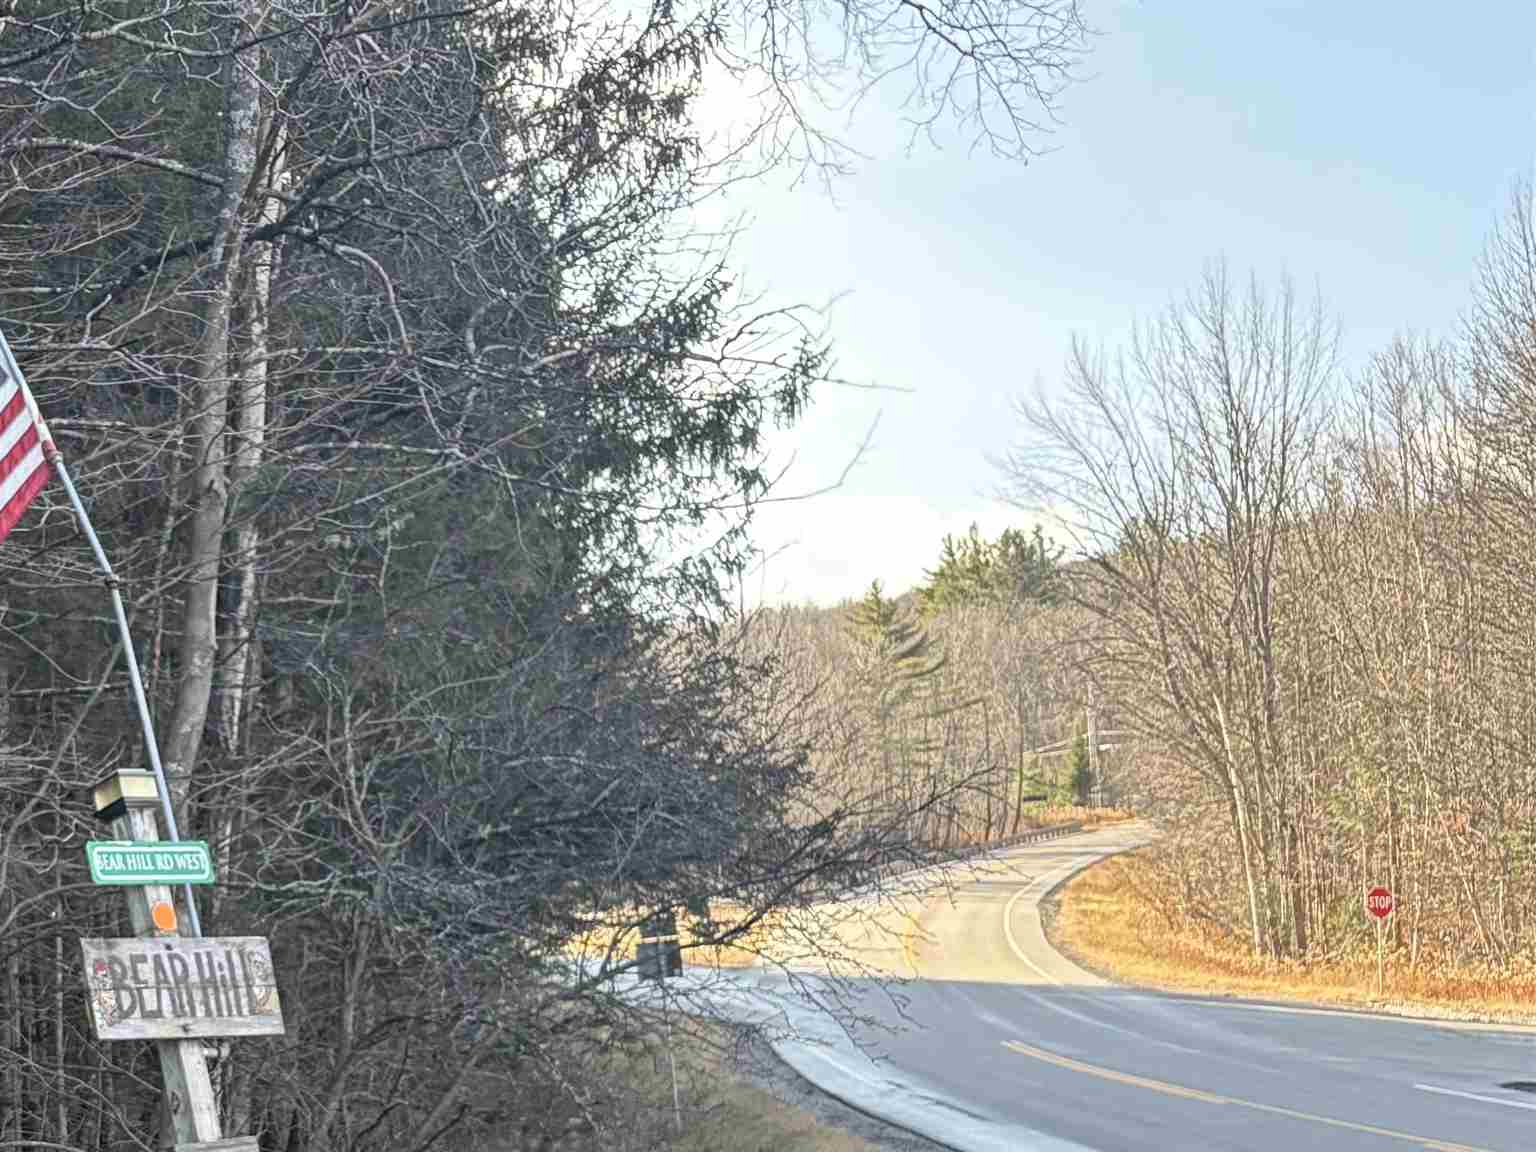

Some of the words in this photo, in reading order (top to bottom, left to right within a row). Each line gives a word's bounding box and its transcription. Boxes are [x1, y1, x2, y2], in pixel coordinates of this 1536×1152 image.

[95, 853, 126, 871] BEAR
[125, 853, 155, 871] HILL
[157, 853, 174, 871] RD
[174, 853, 205, 871] WEST
[1369, 895, 1393, 909] STOP
[109, 951, 195, 1020] BEAR
